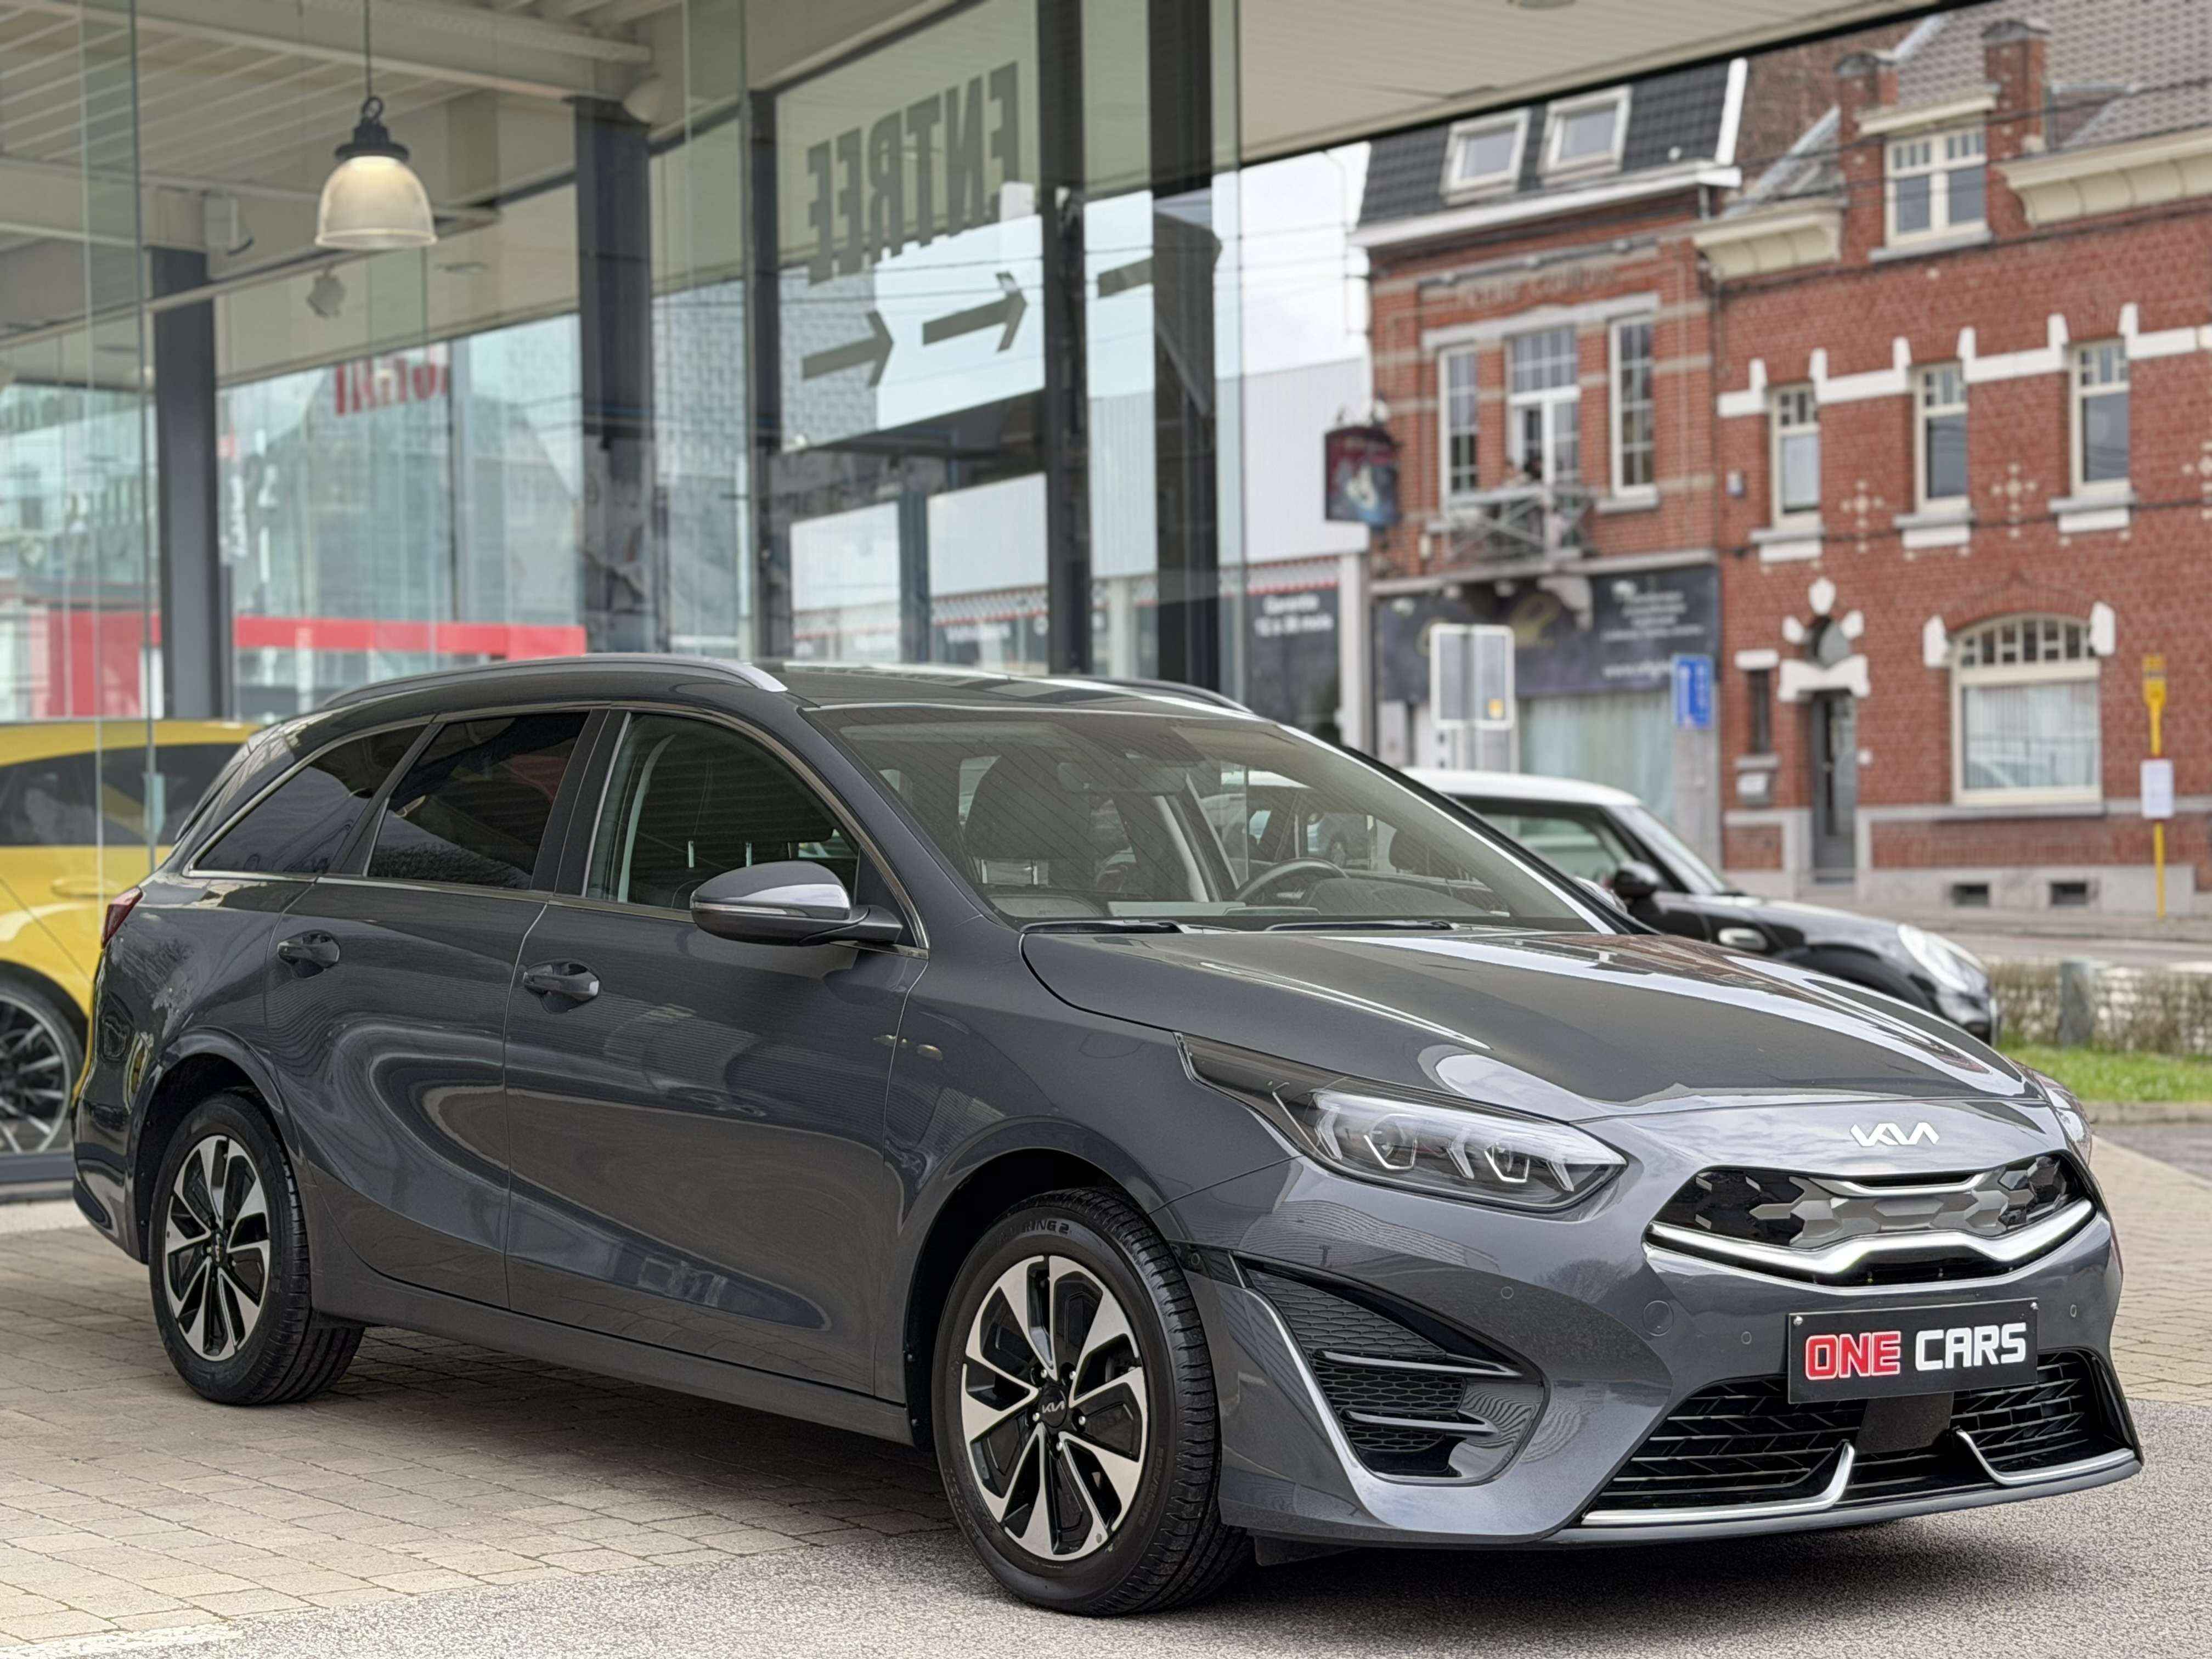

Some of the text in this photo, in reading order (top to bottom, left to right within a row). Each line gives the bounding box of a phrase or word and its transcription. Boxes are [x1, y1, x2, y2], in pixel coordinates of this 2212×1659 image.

[1850, 1122, 1939, 1147] KIA
[1805, 1322, 2027, 1380] ONE CARS
